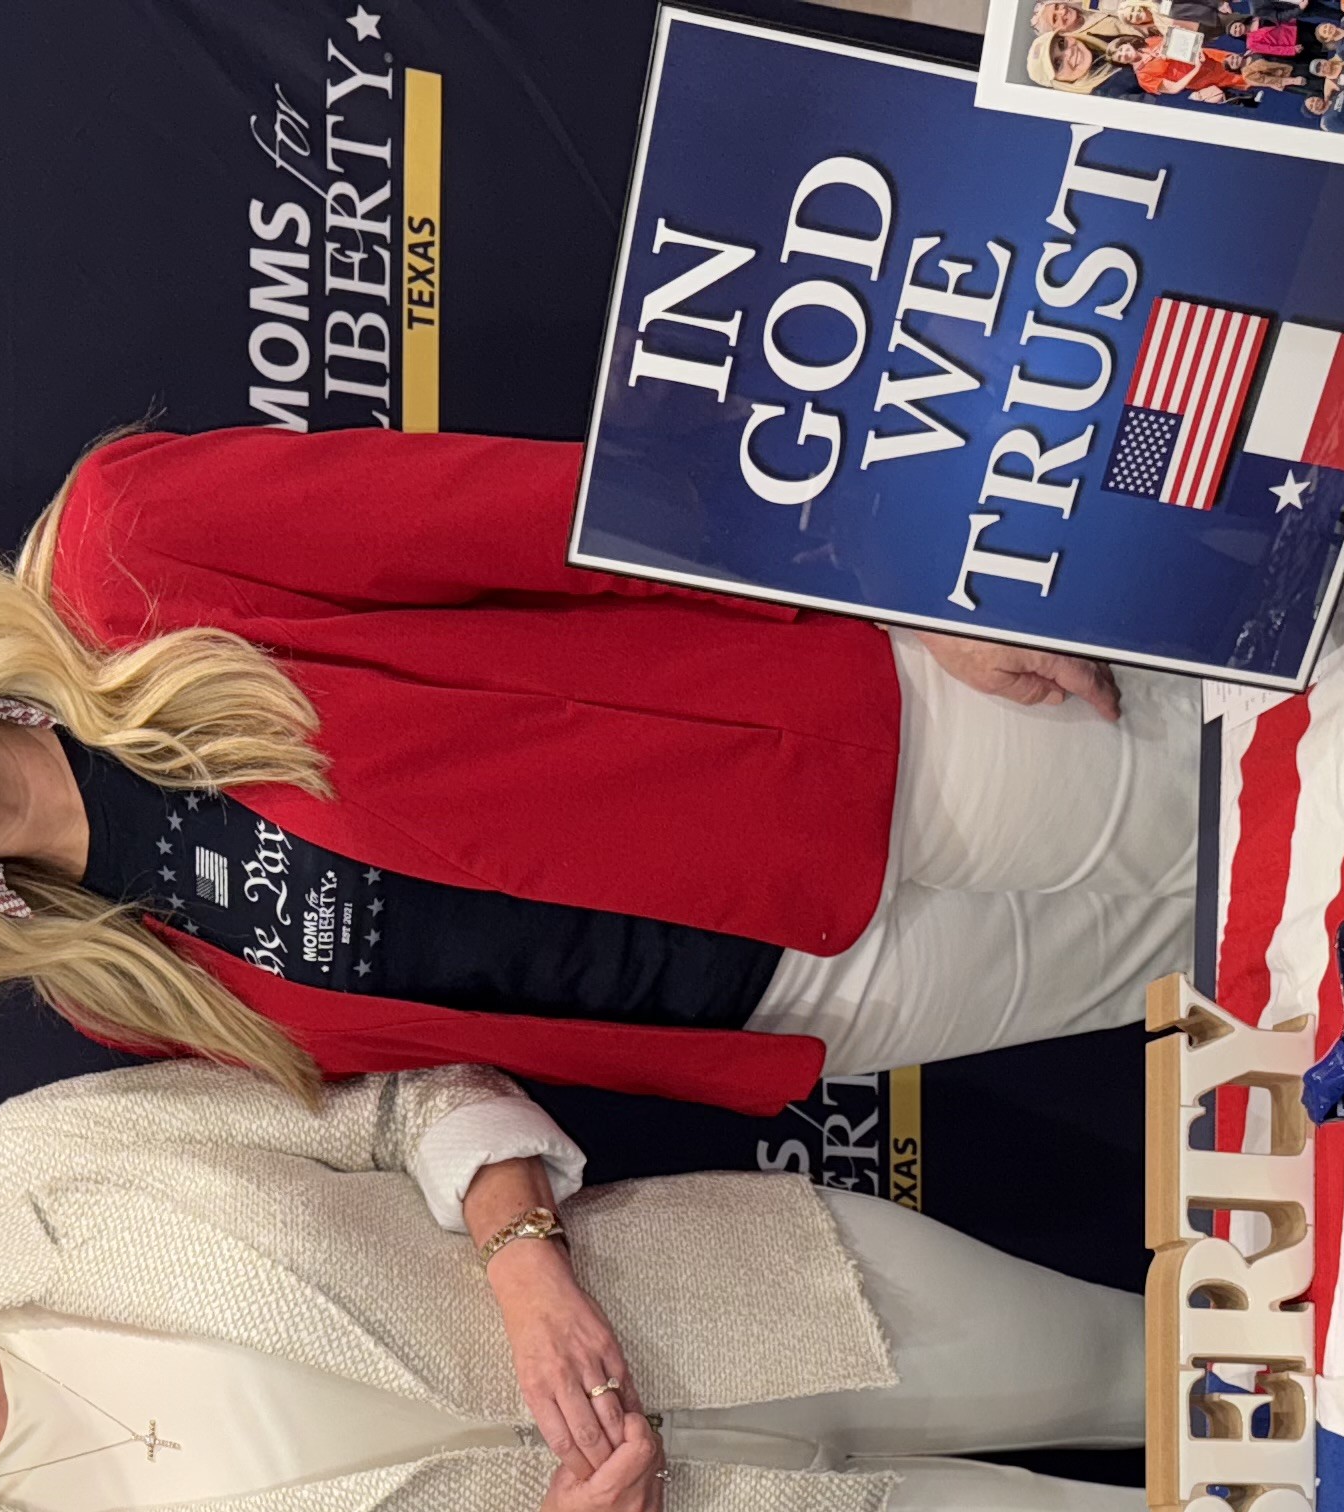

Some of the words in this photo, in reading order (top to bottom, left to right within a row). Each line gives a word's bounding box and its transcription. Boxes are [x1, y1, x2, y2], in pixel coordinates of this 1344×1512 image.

[324, 37, 393, 429] IBERTY
[407, 216, 436, 330] TEXAS
[627, 217, 756, 403] IN
[739, 155, 894, 505] GOD
[859, 233, 1013, 470] WE
[947, 123, 1168, 611] TRUST
[303, 911, 318, 962] MOMS
[305, 888, 322, 912] for
[317, 877, 337, 962] LIBERTY
[341, 926, 352, 944] EST
[342, 902, 353, 924] 2021
